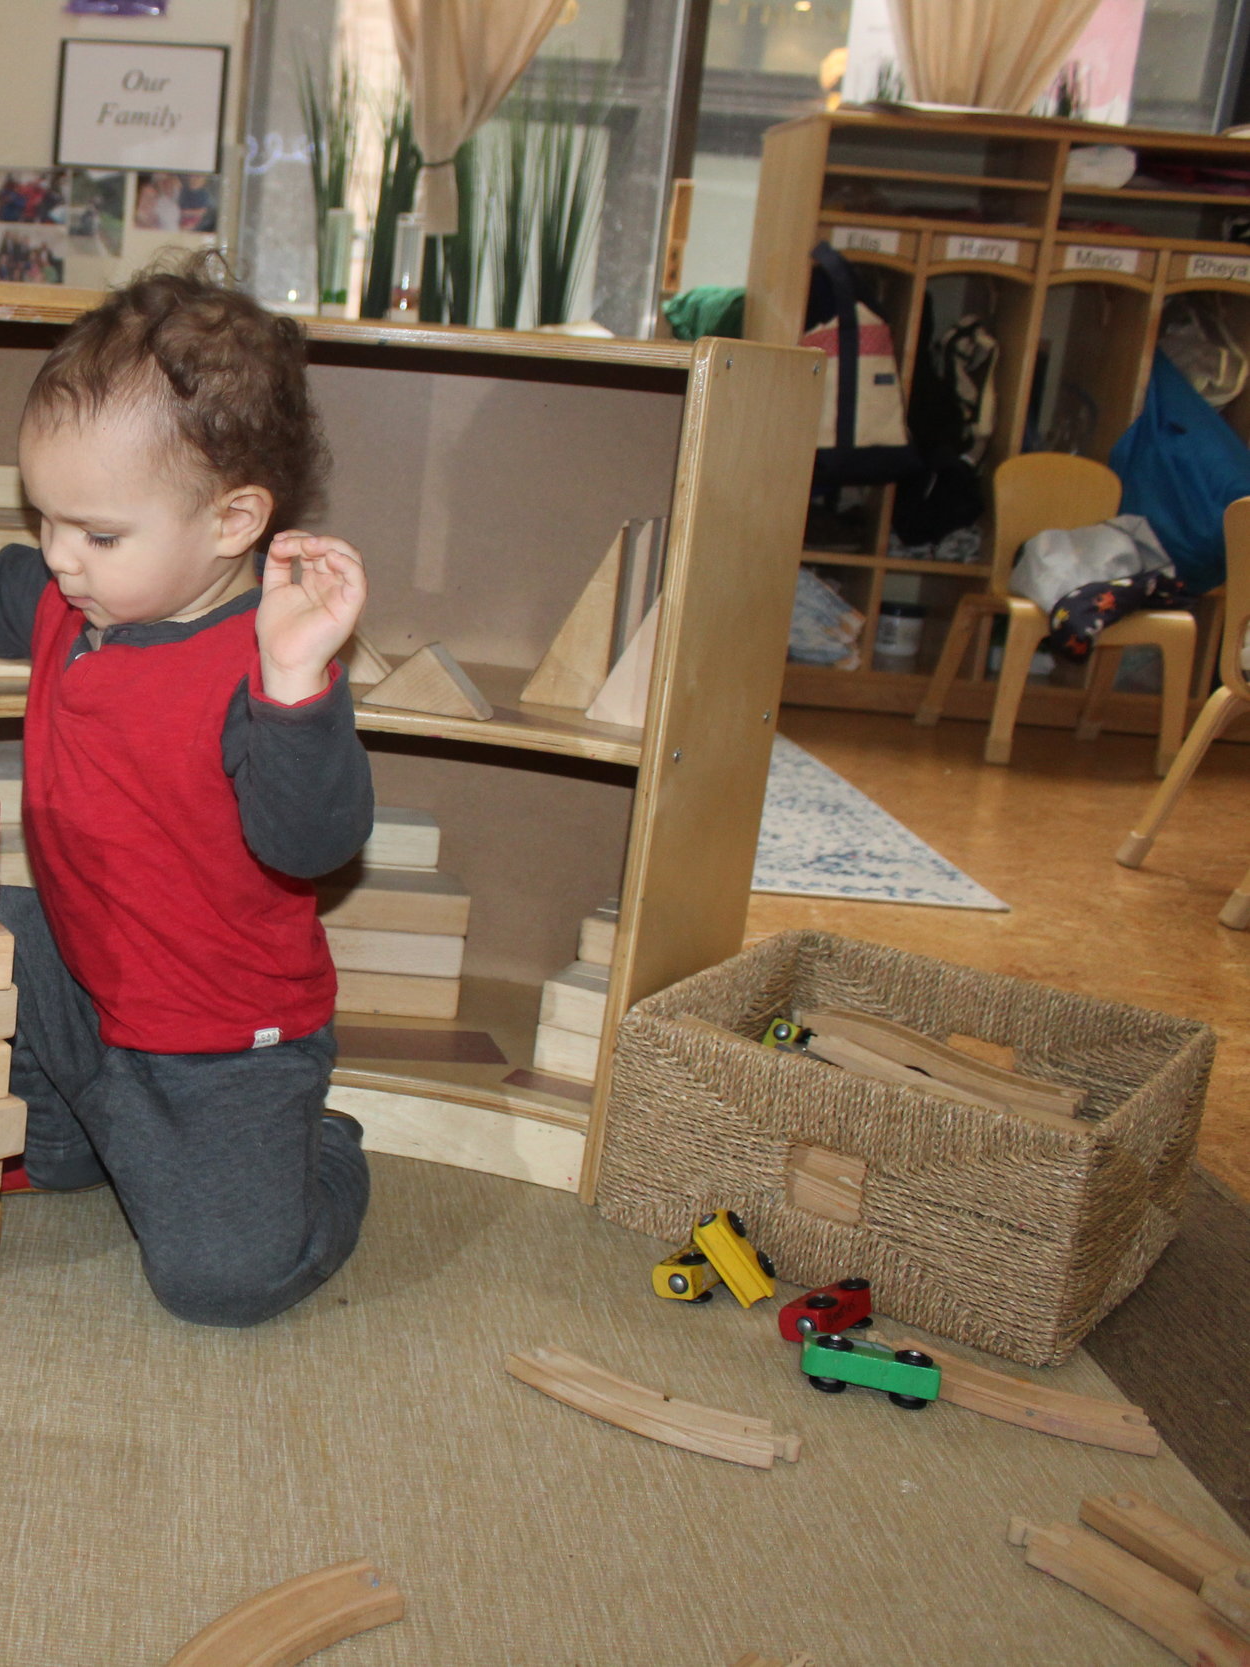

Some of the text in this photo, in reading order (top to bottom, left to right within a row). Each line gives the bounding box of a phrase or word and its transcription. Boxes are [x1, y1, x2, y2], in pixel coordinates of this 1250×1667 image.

[121, 68, 171, 92] Our
[96, 102, 182, 132] Family
[1075, 249, 1123, 270] Mario
